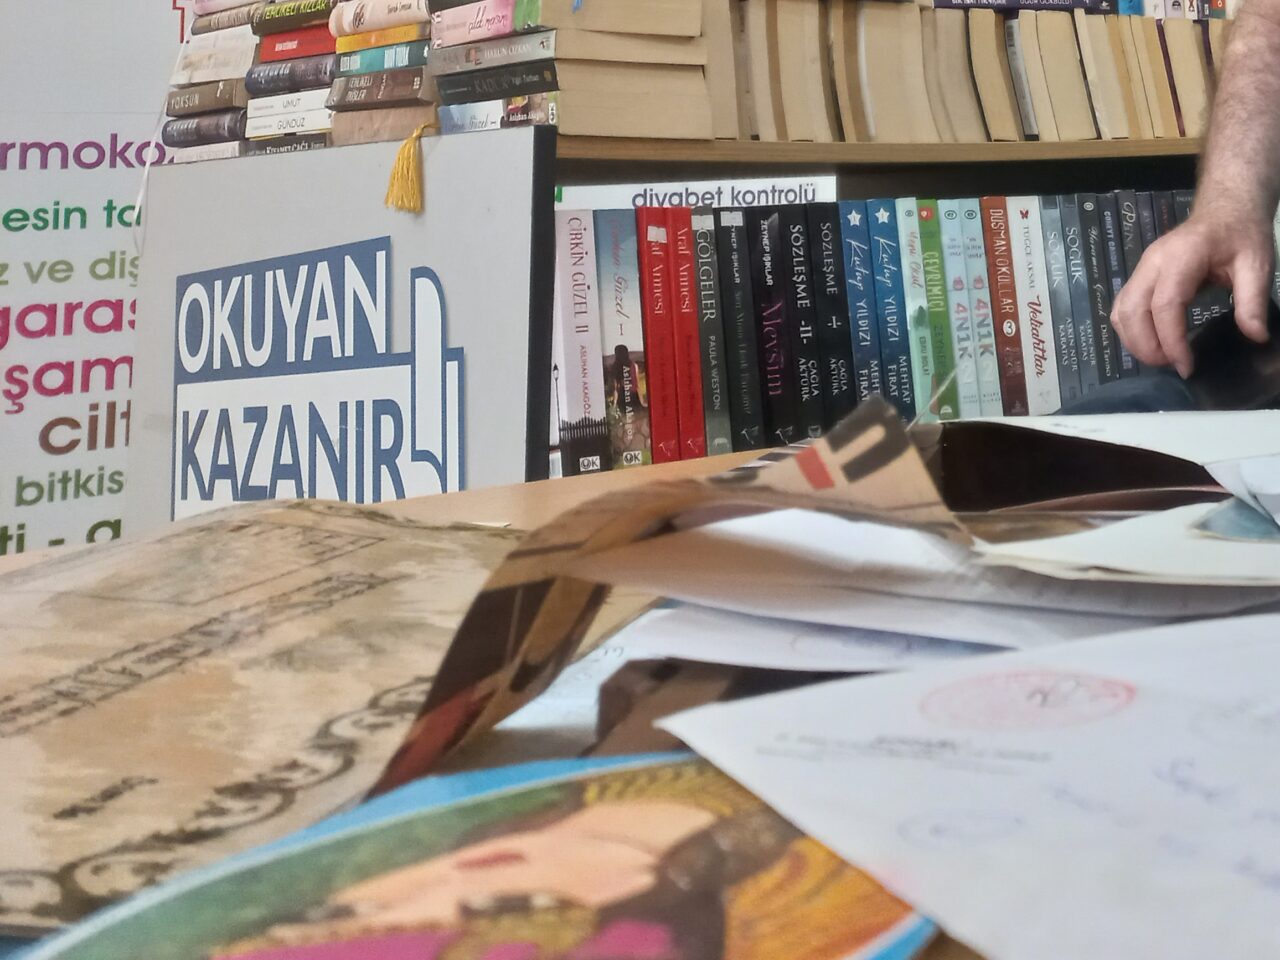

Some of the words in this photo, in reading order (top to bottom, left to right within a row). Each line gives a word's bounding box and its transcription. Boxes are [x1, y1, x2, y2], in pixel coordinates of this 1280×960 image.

[0, 132, 176, 171] rmoko
[2, 200, 88, 233] esin
[730, 182, 817, 206] kontrolü
[566, 216, 586, 267] ÇİRKİN
[820, 222, 839, 296] SÖZLEŞME
[846, 237, 870, 292] Kutup
[874, 235, 899, 289] Kutup
[23, 258, 75, 285] ve
[697, 228, 717, 323] GÖLGELER
[789, 224, 811, 309] SÖZLEŞME
[177, 250, 388, 375] OKUYAN
[570, 271, 589, 320] GÜZEL
[884, 295, 900, 343] YILDIZI
[856, 298, 871, 348] YILDIZI
[709, 335, 719, 368] PAULA
[711, 368, 722, 411] WESTON
[887, 363, 899, 398] FIRAT
[898, 355, 912, 405] MEHTAP
[179, 397, 407, 504] KAZANIR
[15, 465, 125, 508] bitkis
